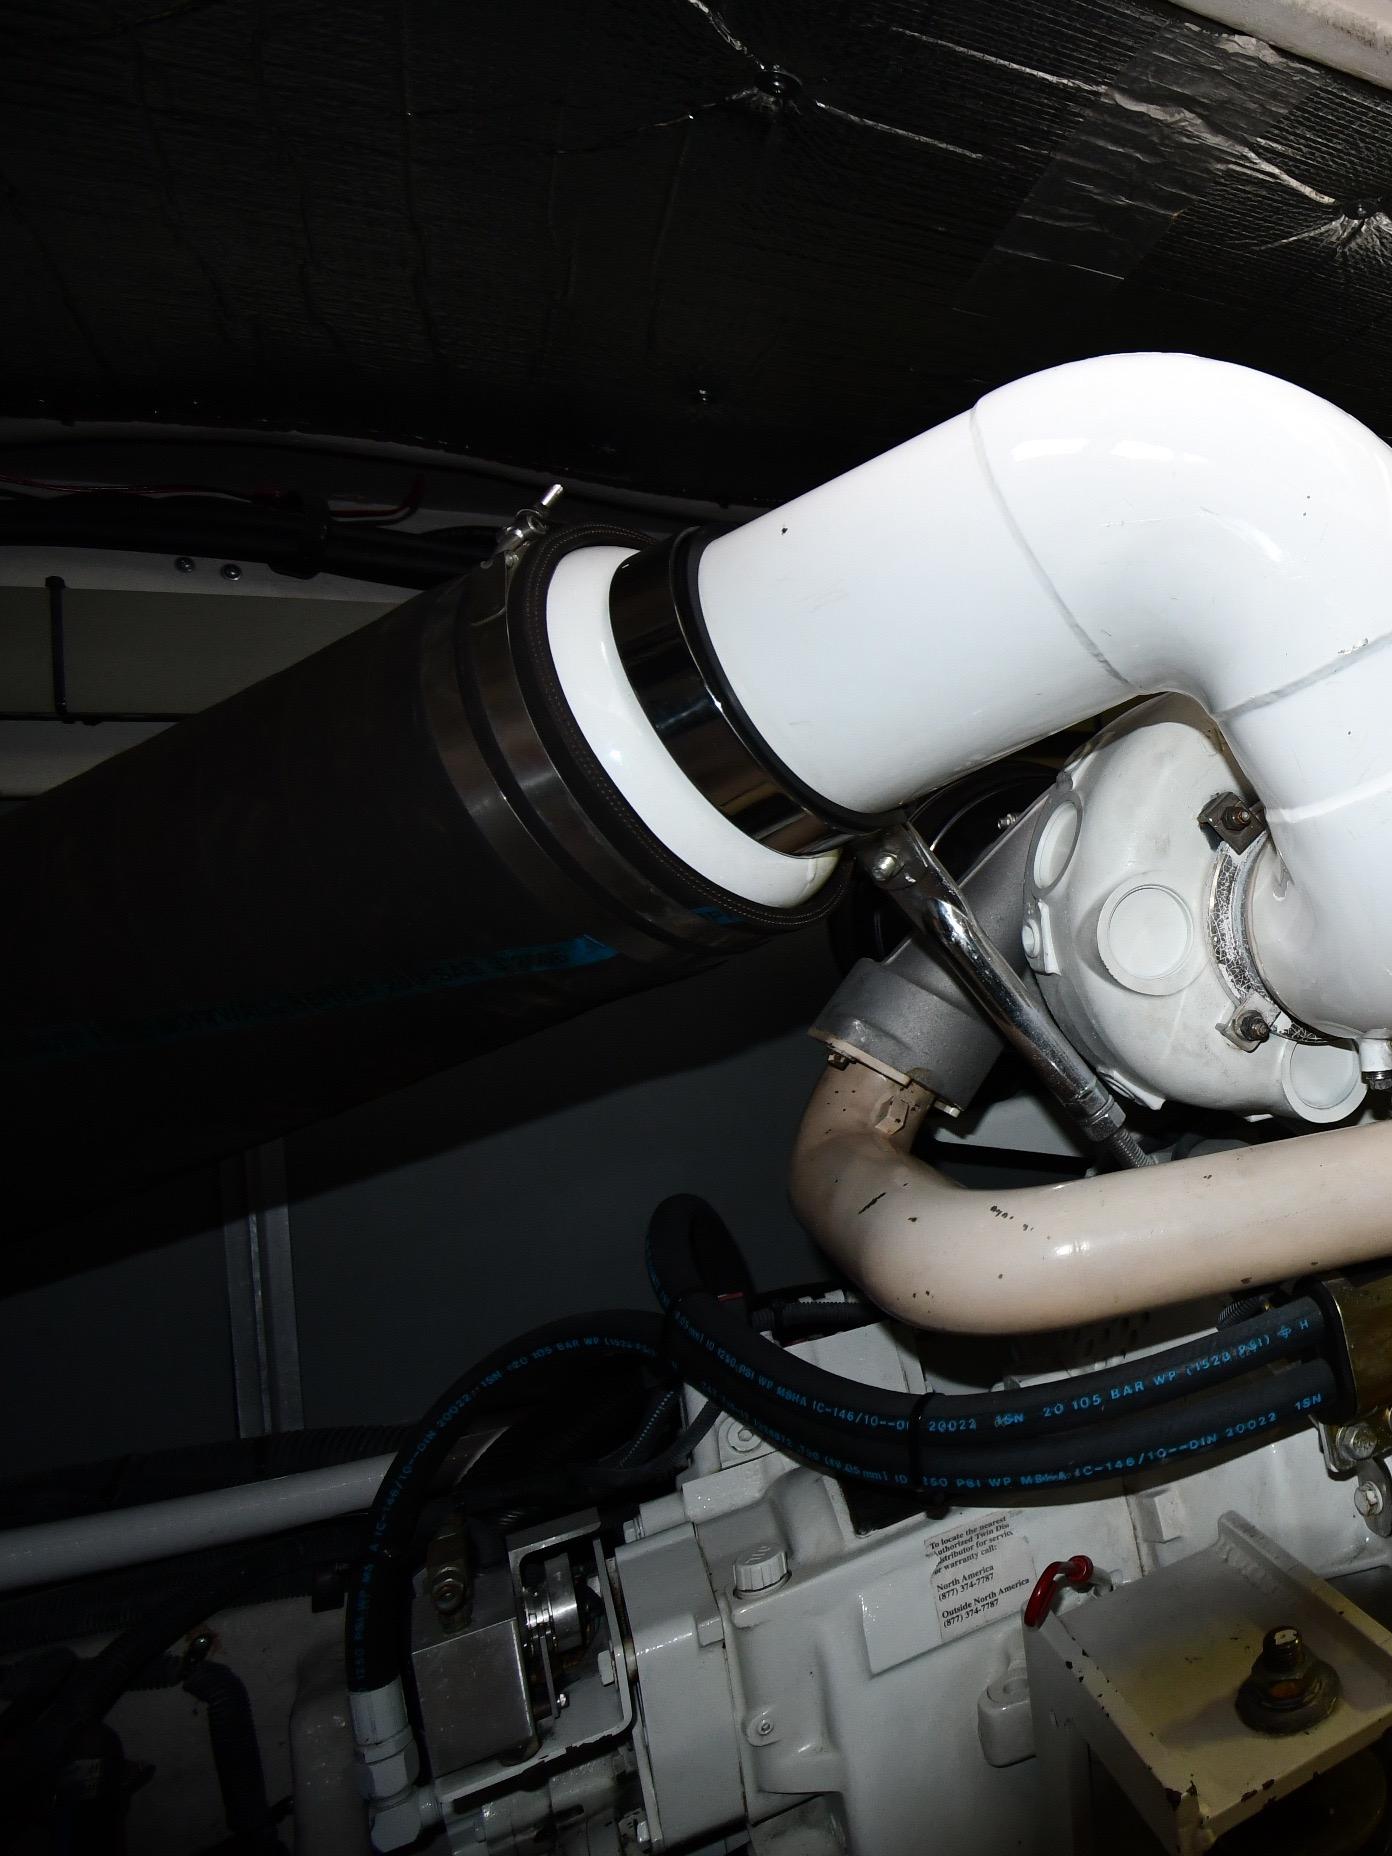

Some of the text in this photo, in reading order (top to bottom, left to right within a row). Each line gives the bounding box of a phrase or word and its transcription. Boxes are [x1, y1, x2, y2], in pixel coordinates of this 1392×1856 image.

[556, 1338, 580, 1351] BAR
[812, 1400, 910, 1433] IC-146/10--DI
[1042, 1402, 1065, 1417] 20
[1071, 1393, 1102, 1411] 105
[1109, 1380, 1146, 1401] BAR
[1153, 1370, 1177, 1387] WP
[919, 1474, 949, 1488] 250
[955, 1477, 981, 1489] PSI
[987, 1475, 1012, 1489] WP
[1223, 1410, 1279, 1438] 20022
[1294, 1393, 1325, 1411] 1SN
[941, 1533, 964, 1545] locate
[965, 1527, 977, 1536] the
[979, 1516, 1006, 1530] nearest
[974, 1528, 994, 1540] Twin
[975, 1540, 988, 1550] for
[943, 1551, 979, 1570] warranty
[981, 1544, 998, 1555] call:
[937, 1565, 994, 1592] North America
[938, 1573, 994, 1602] (877) 374-7787
[942, 1578, 1030, 1619] Outside North America
[943, 1598, 999, 1629] (877) 374-7787
